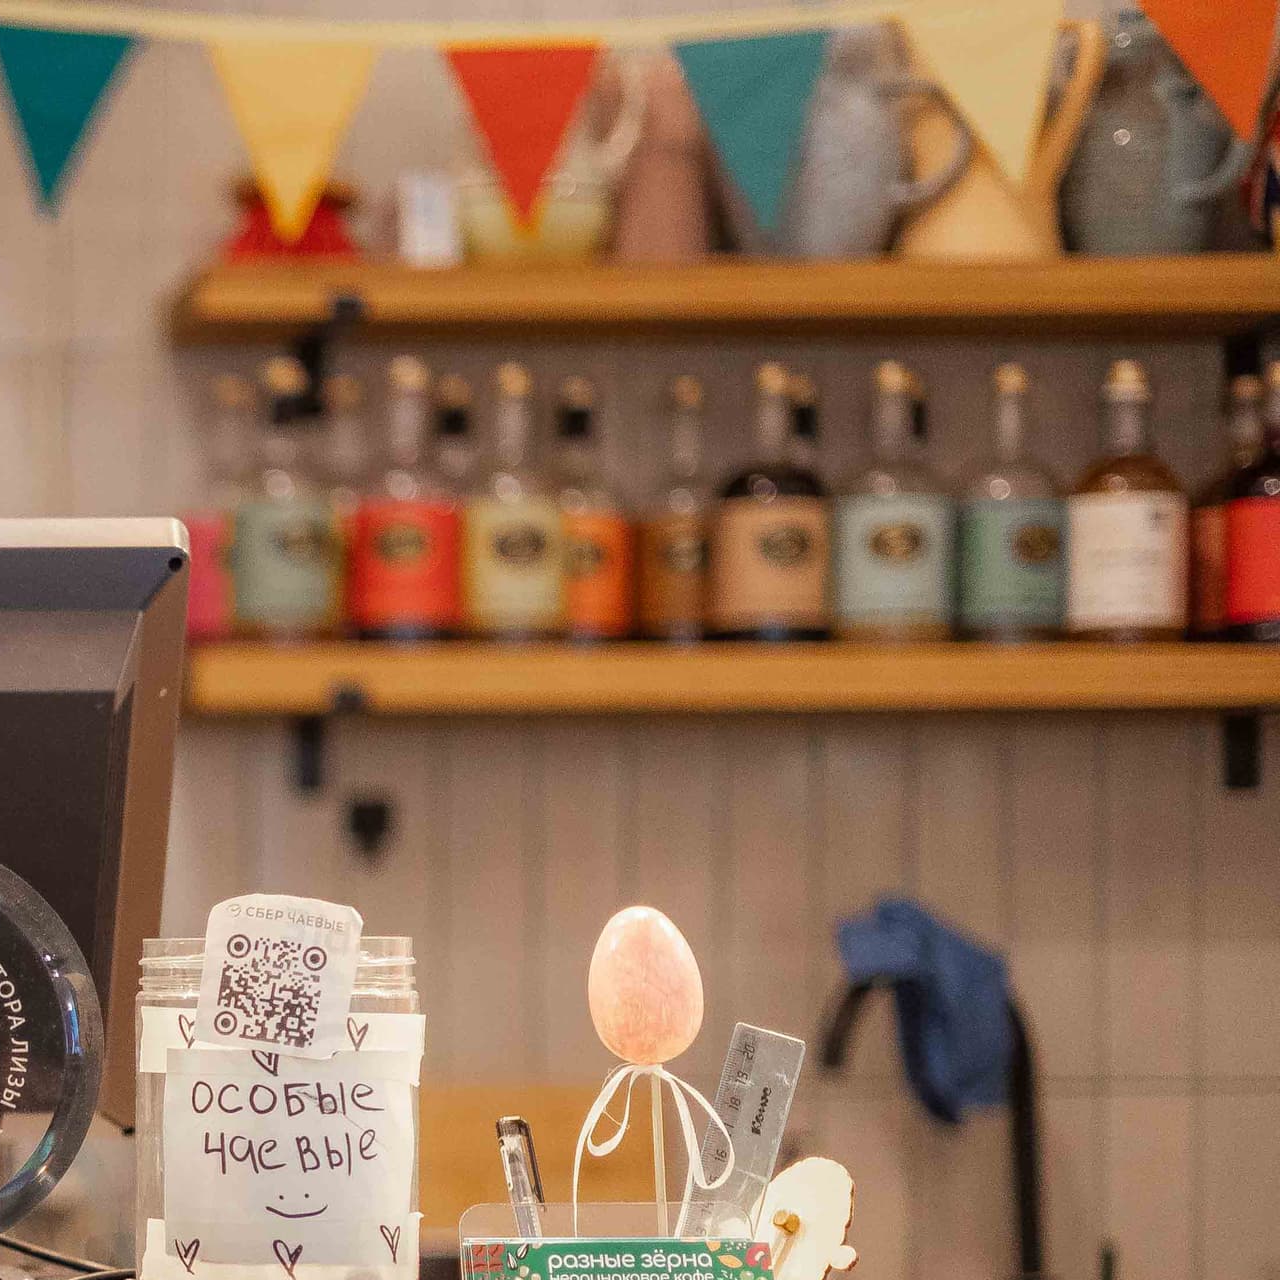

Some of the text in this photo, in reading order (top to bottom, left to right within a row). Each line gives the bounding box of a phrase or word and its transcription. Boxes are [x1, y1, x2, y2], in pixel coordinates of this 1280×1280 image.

[246, 906, 344, 932] СБЕР ЧАЕВЫЕ
[0, 1036, 30, 1111] ЛИЗЫ
[547, 1248, 713, 1273] разные зёрна
